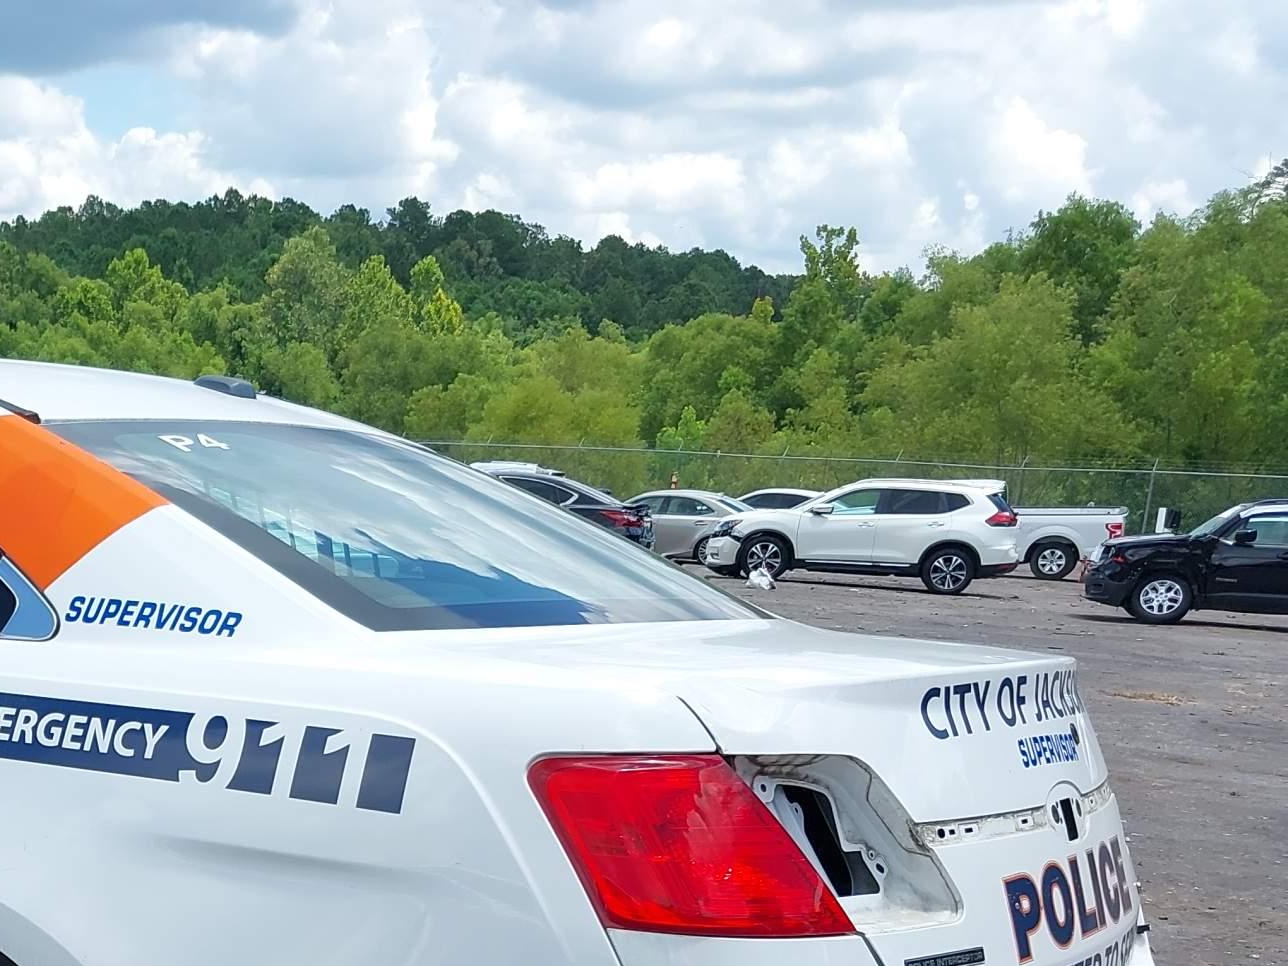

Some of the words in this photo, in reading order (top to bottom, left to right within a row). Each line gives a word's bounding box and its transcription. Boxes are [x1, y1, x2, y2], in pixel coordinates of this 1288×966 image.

[158, 433, 231, 452] P4
[64, 595, 243, 638] SUPERVISOR
[921, 680, 991, 740] CITY
[997, 675, 1028, 727] OF
[1035, 670, 1084, 722] JACKSO
[185, 711, 384, 812] 911
[1018, 733, 1079, 768] SUPERVISOR
[1001, 834, 1133, 965] POLICE
